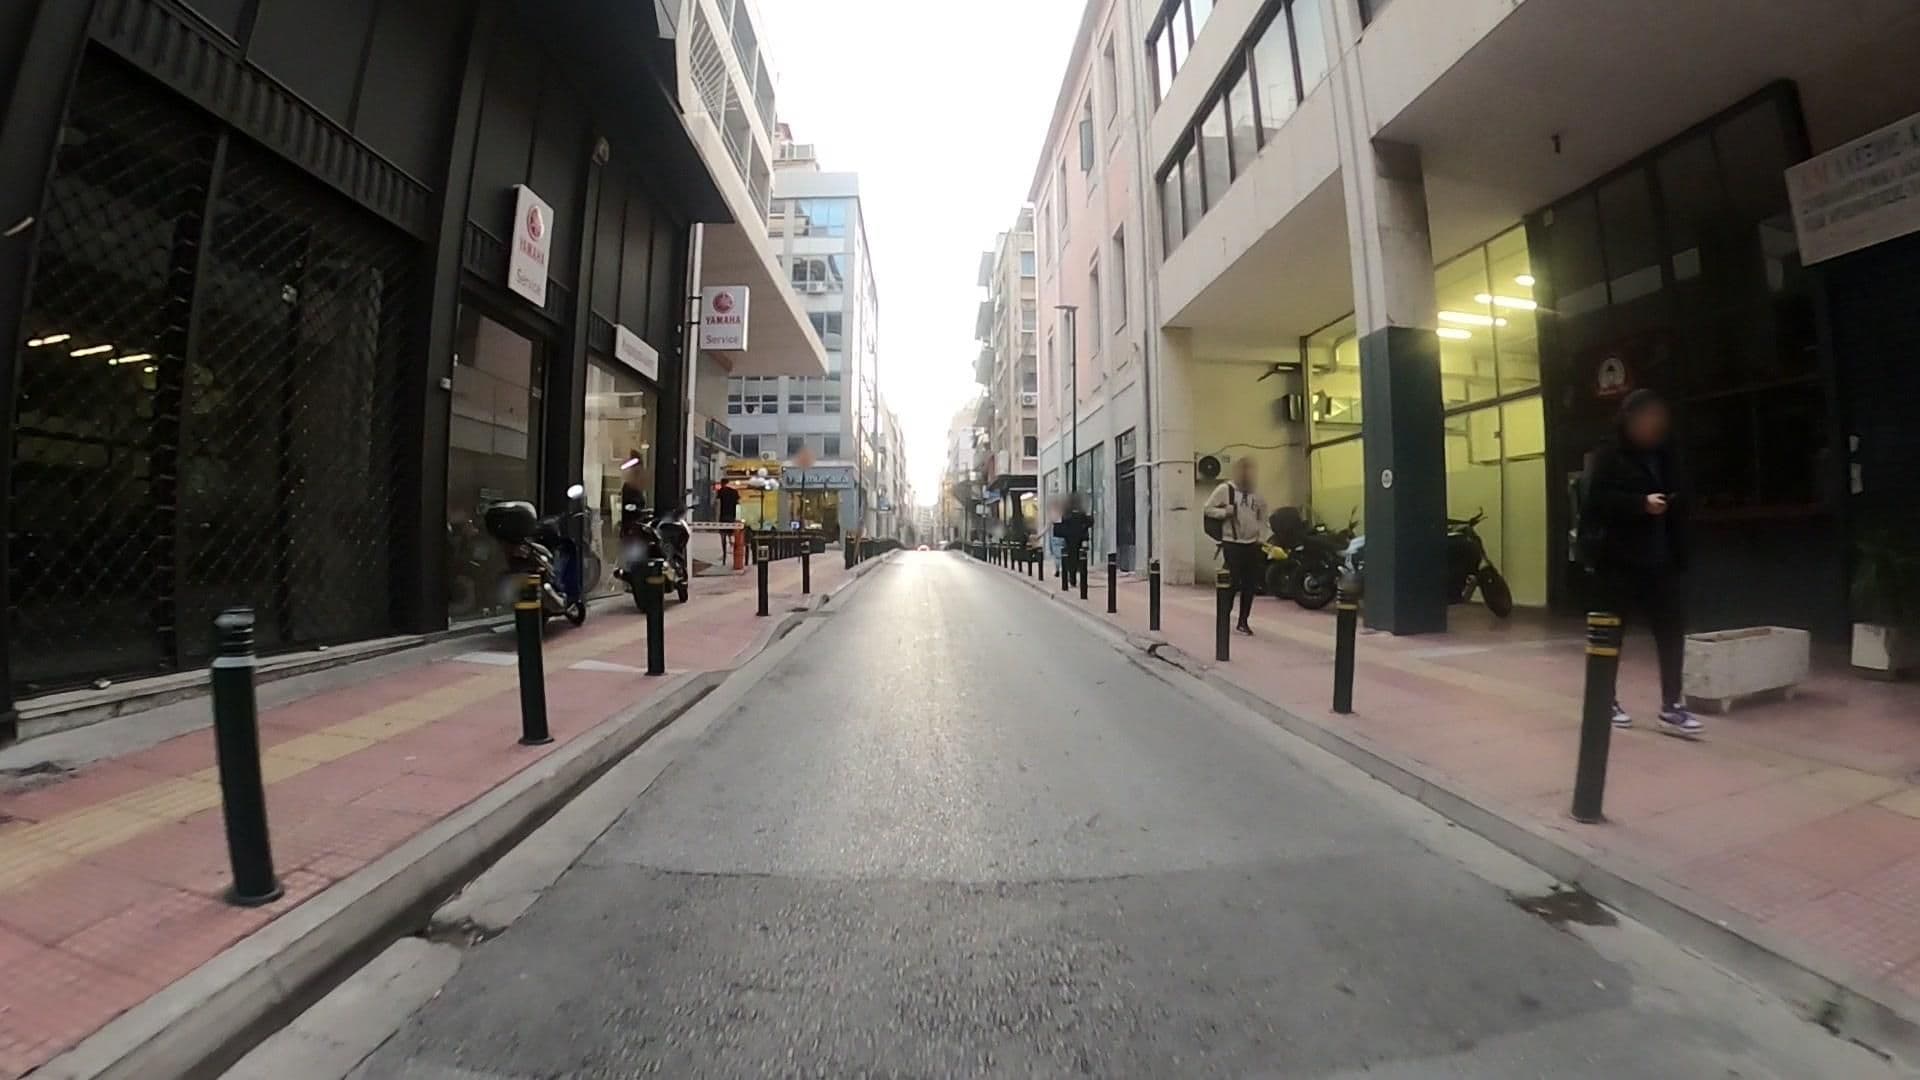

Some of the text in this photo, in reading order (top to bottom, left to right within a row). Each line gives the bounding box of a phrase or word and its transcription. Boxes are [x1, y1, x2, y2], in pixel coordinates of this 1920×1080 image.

[519, 238, 544, 264] YAMAHA
[705, 316, 741, 325] YAMAHA
[705, 334, 739, 344] Service
